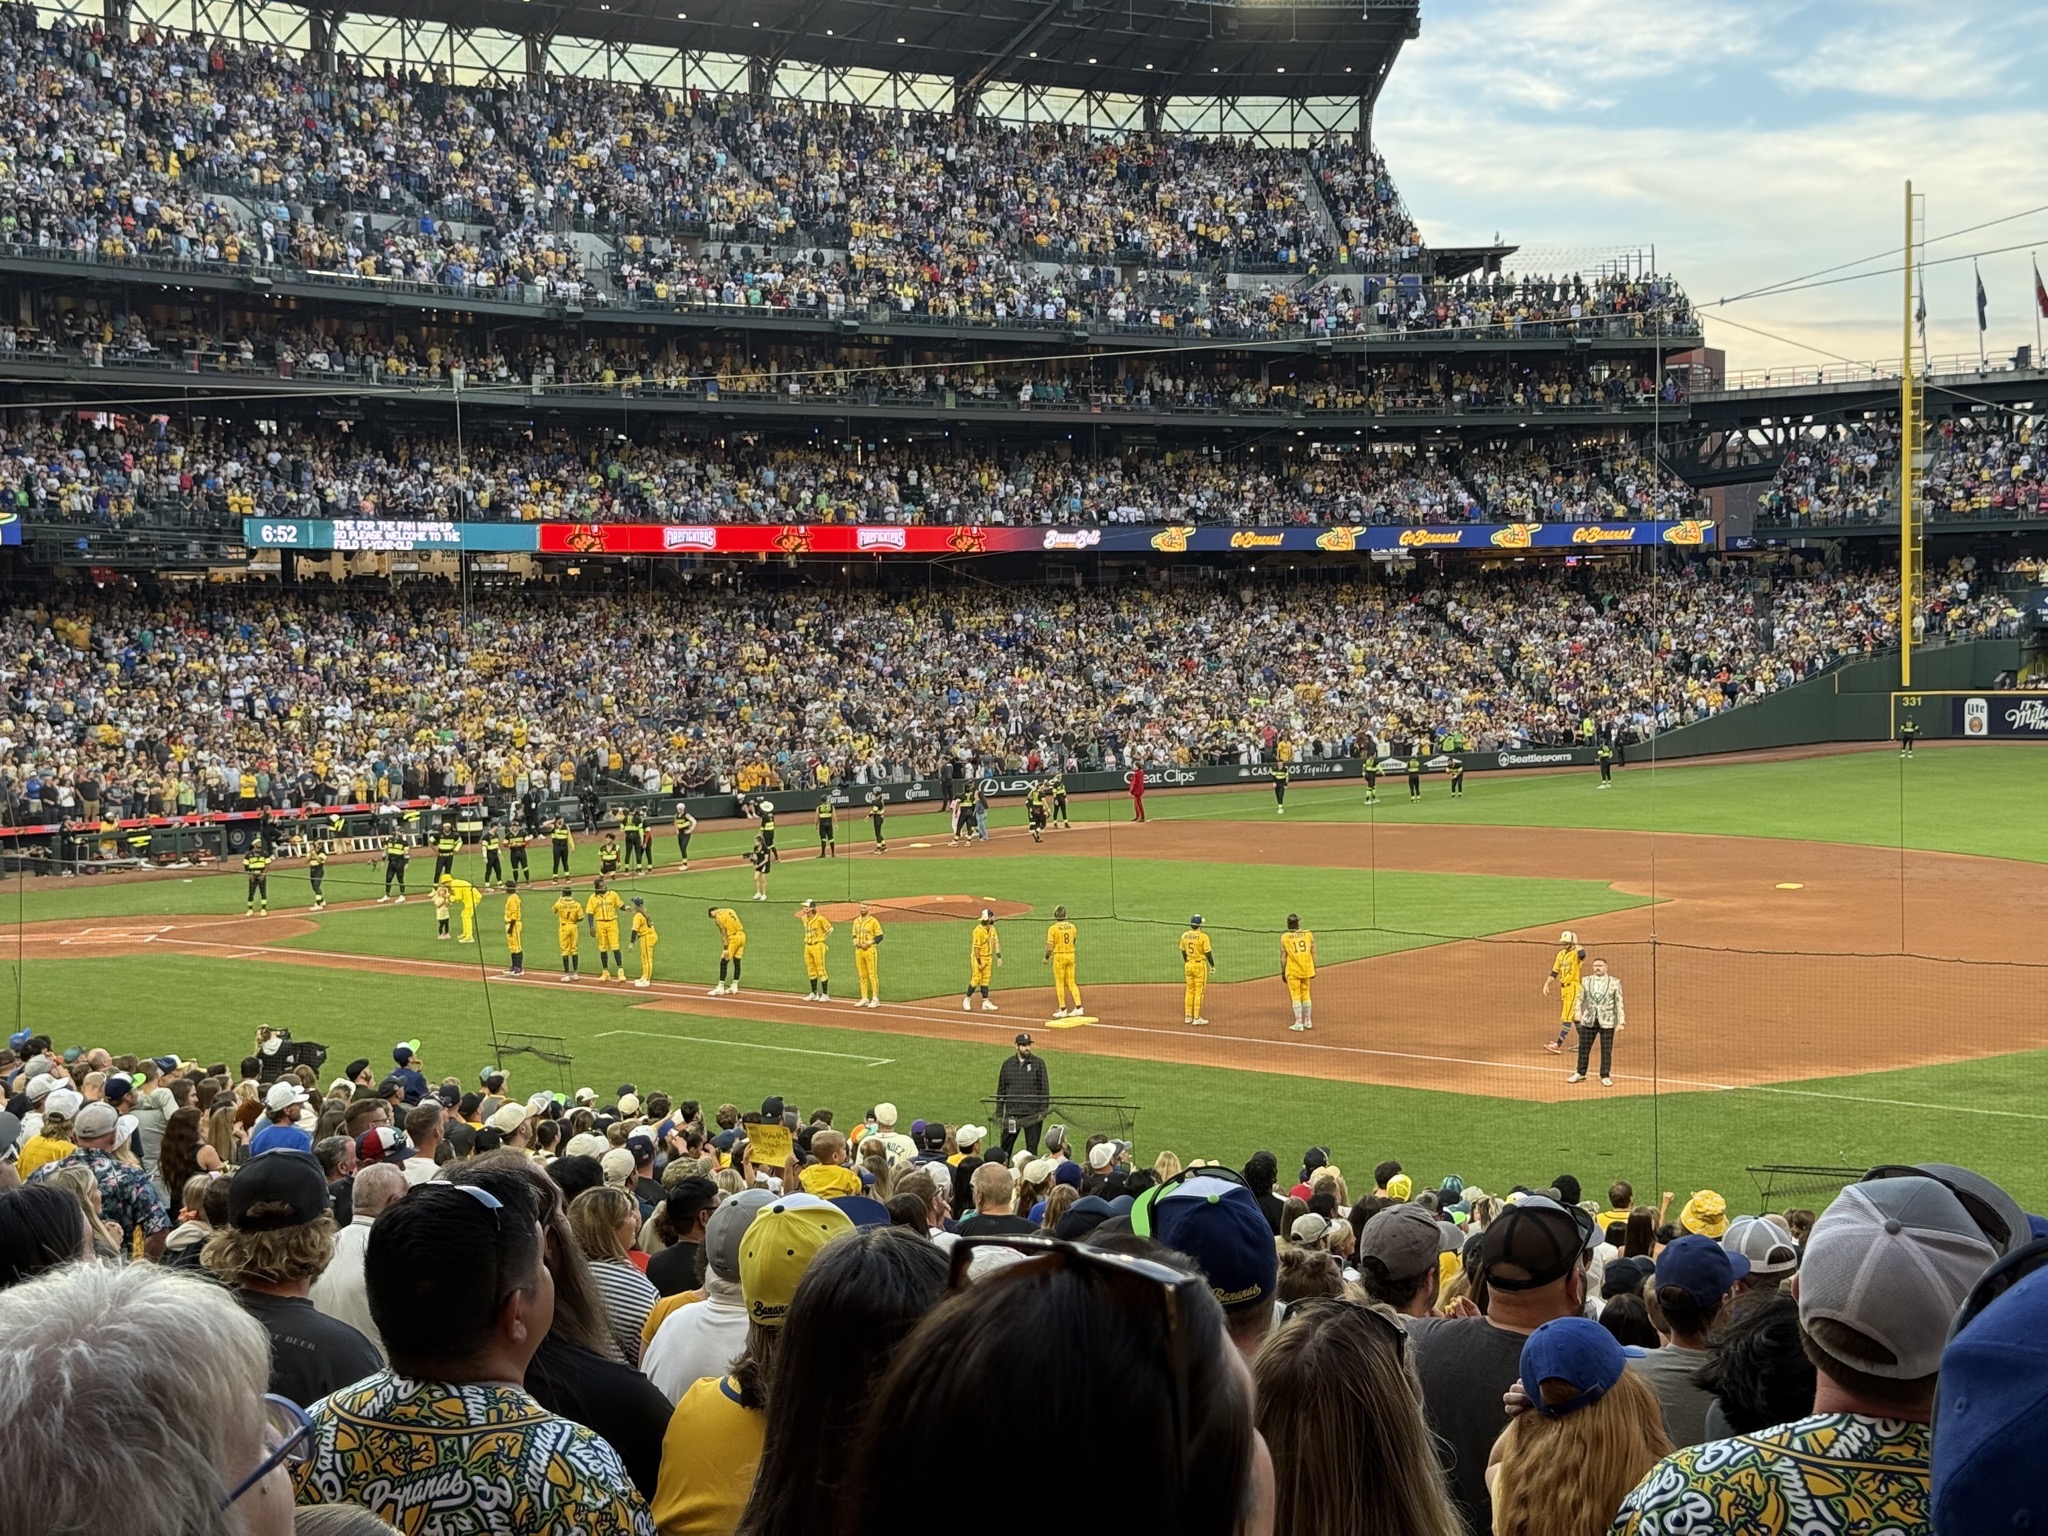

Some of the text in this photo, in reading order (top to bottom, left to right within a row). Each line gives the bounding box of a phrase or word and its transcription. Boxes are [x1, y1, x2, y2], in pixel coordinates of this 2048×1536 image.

[333, 520, 355, 530] TIME
[357, 520, 375, 530] FOR
[377, 521, 395, 531] THE
[397, 521, 416, 531] FAN
[261, 524, 298, 543] 6:52
[333, 530, 461, 542] SO PLEASE WELCOME TO THE
[333, 540, 414, 551] FIELD 5-YEAR-OLD
[1902, 696, 1922, 707] 331
[2019, 699, 2044, 712] IT'S
[1967, 703, 1985, 716] Lite
[2005, 704, 2048, 730] Mille
[2029, 719, 2048, 730] TIM
[1303, 763, 1331, 777] Tequila
[1163, 769, 1195, 785] Clips
[865, 791, 890, 803] Cona
[905, 787, 930, 800] Corona
[1063, 932, 1070, 944] 8
[1188, 942, 1195, 954] 5
[1292, 940, 1307, 953] 19
[285, 1335, 316, 1351] BEER
